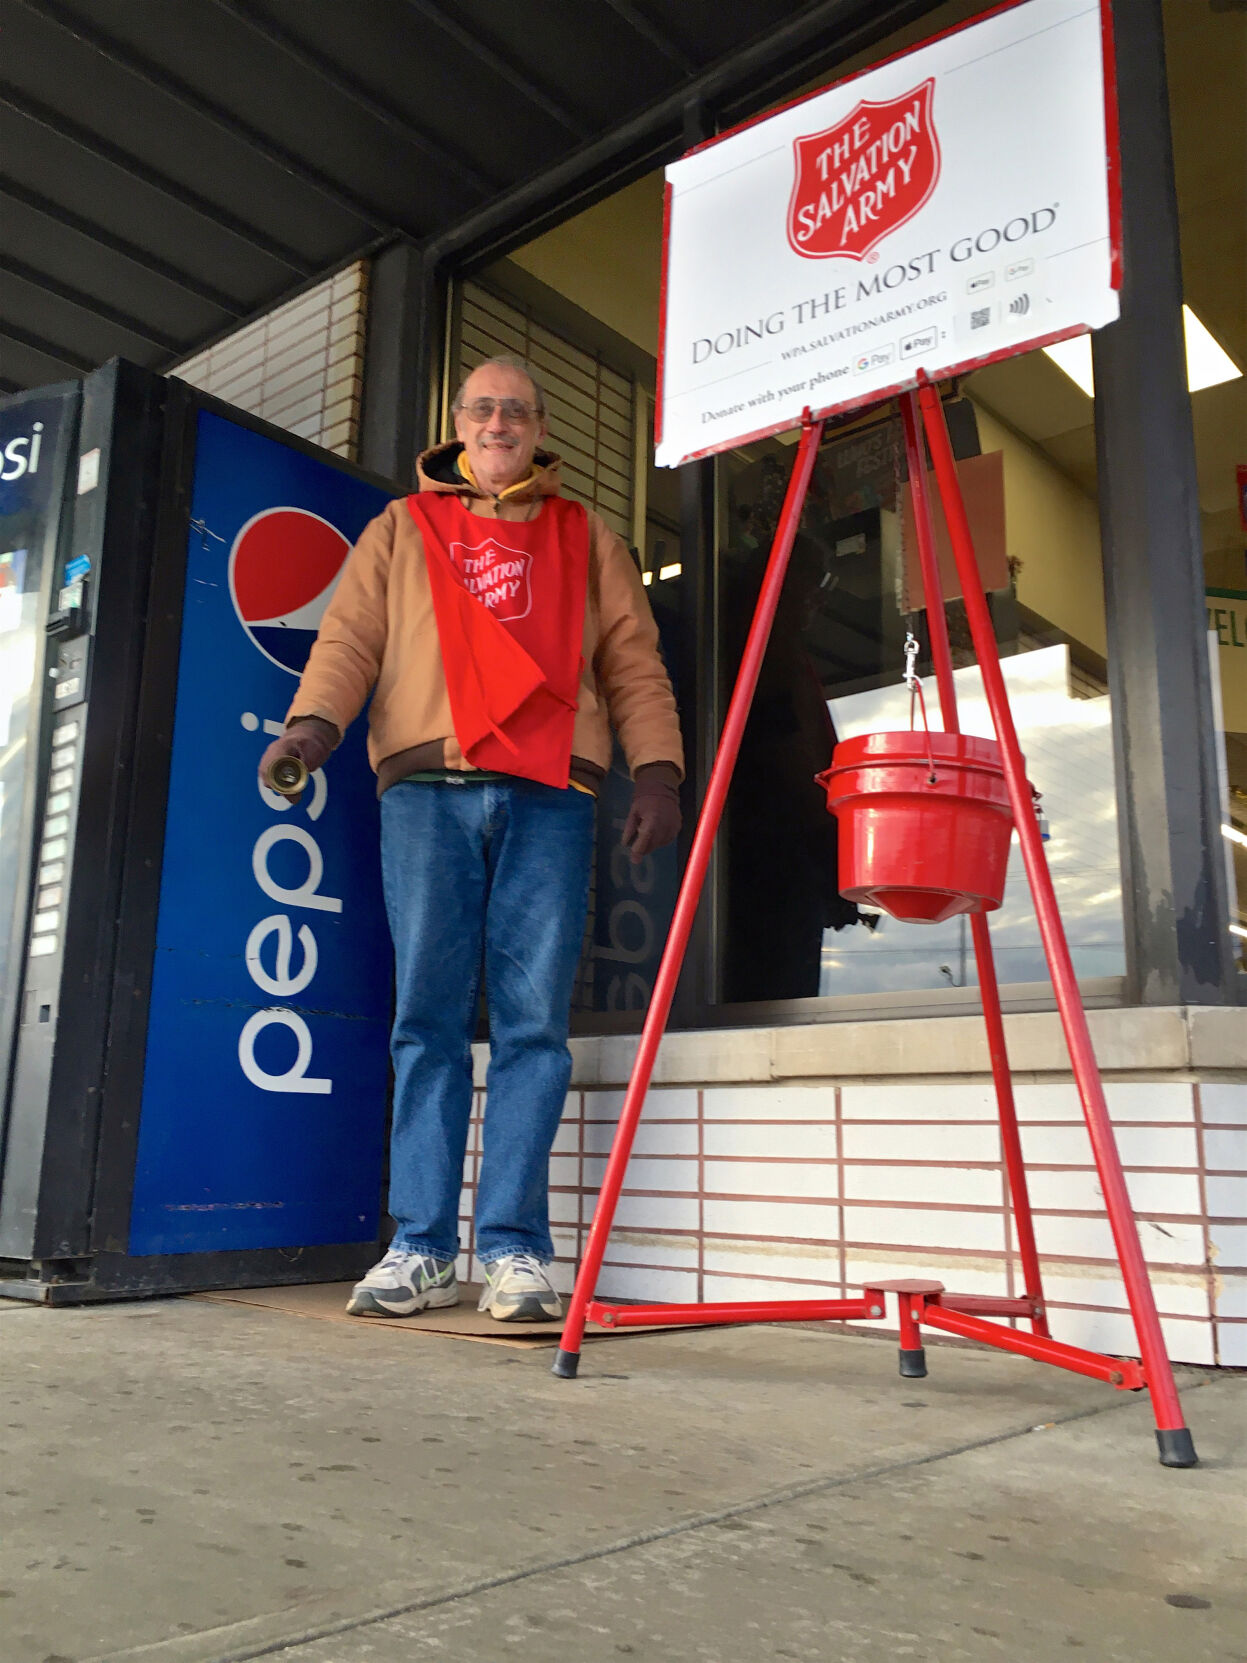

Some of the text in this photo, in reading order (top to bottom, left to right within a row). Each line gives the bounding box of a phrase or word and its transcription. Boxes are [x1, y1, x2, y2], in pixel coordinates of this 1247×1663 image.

[797, 100, 921, 242] SALVATION
[816, 116, 871, 181] THE
[839, 145, 918, 247] ARMY
[691, 207, 1057, 364] DOING THE MOST GOOD
[912, 335, 934, 349] Pay
[701, 402, 746, 425] Donate
[747, 390, 775, 408] with
[777, 381, 807, 402] your
[808, 366, 850, 391] phone
[870, 354, 891, 367] Pay
[0, 421, 45, 481] si
[463, 548, 497, 573] THE
[477, 579, 521, 608] RMY
[1206, 608, 1247, 648] EL
